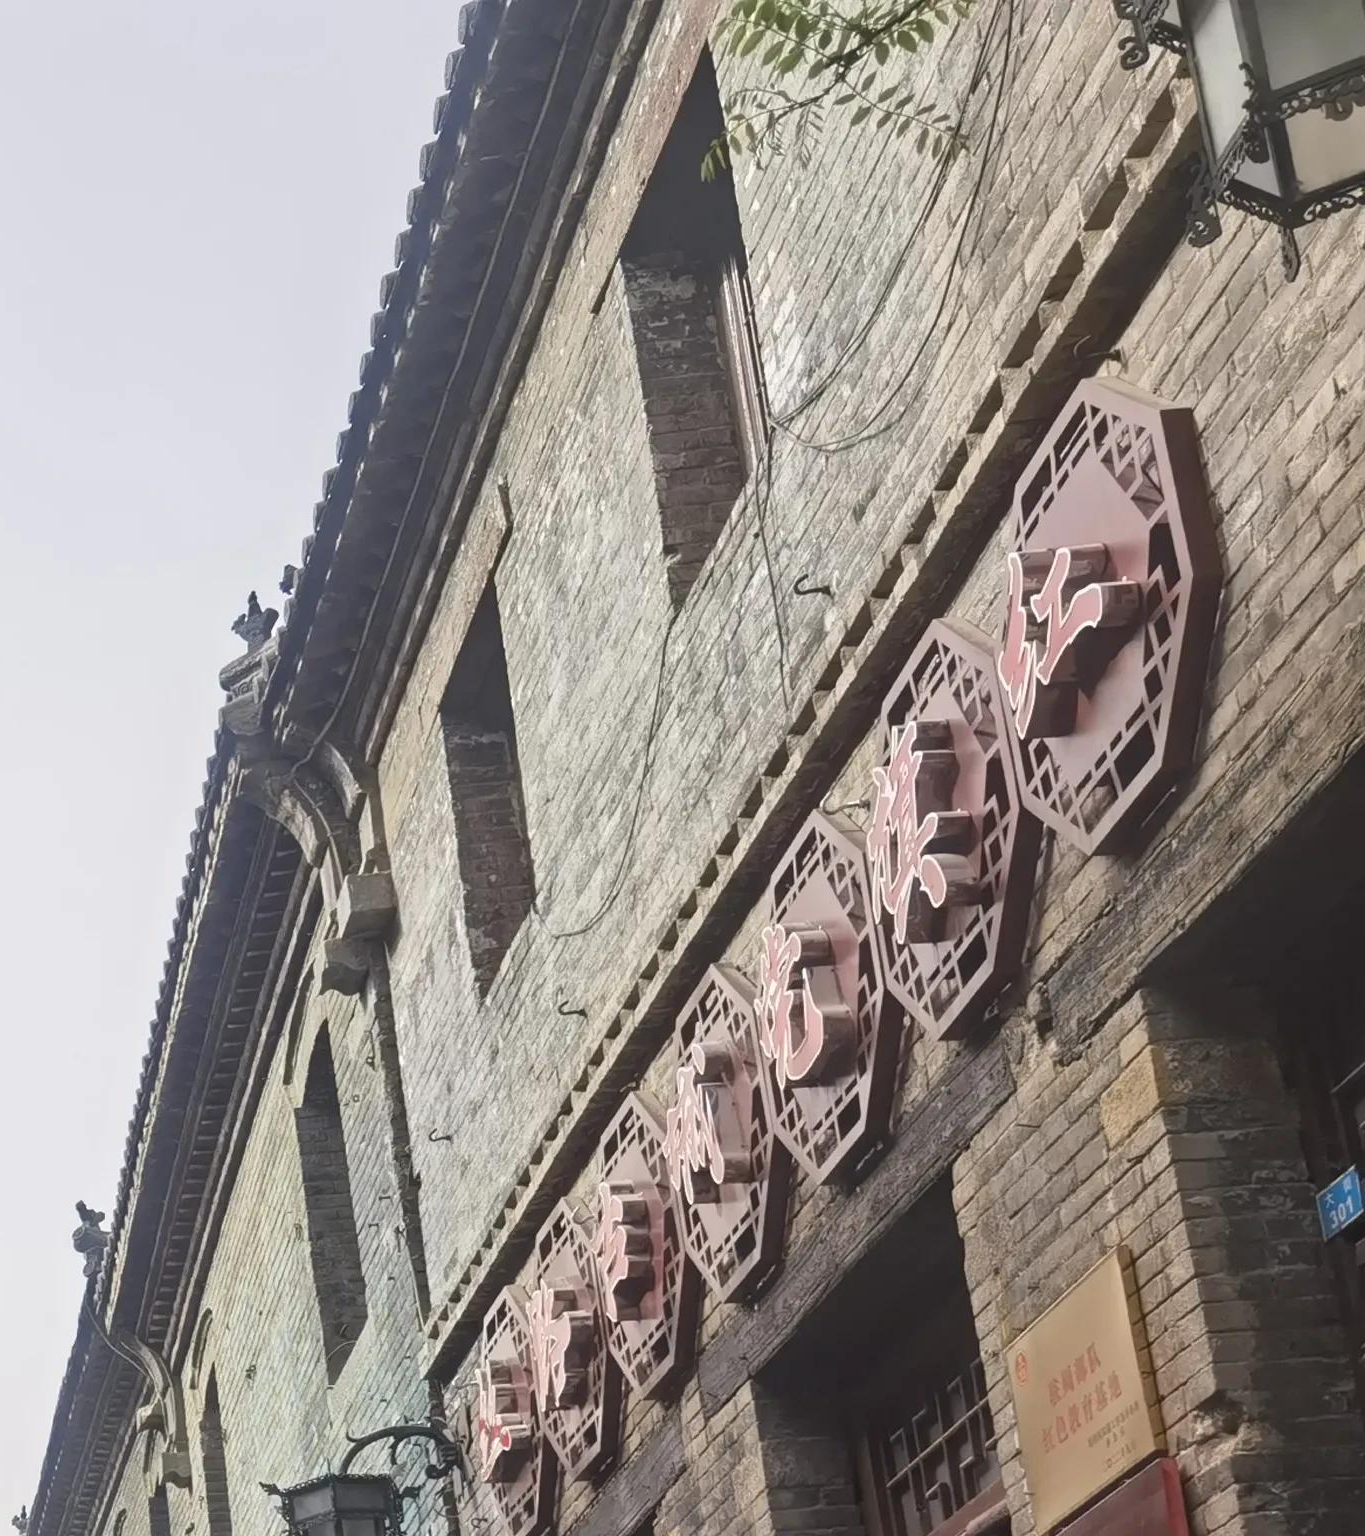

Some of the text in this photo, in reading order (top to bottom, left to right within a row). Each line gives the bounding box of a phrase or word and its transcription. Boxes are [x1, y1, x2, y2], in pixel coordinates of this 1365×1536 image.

[1329, 1197, 1354, 1229] 301
[1041, 1370, 1123, 1454] 红色教育基地
